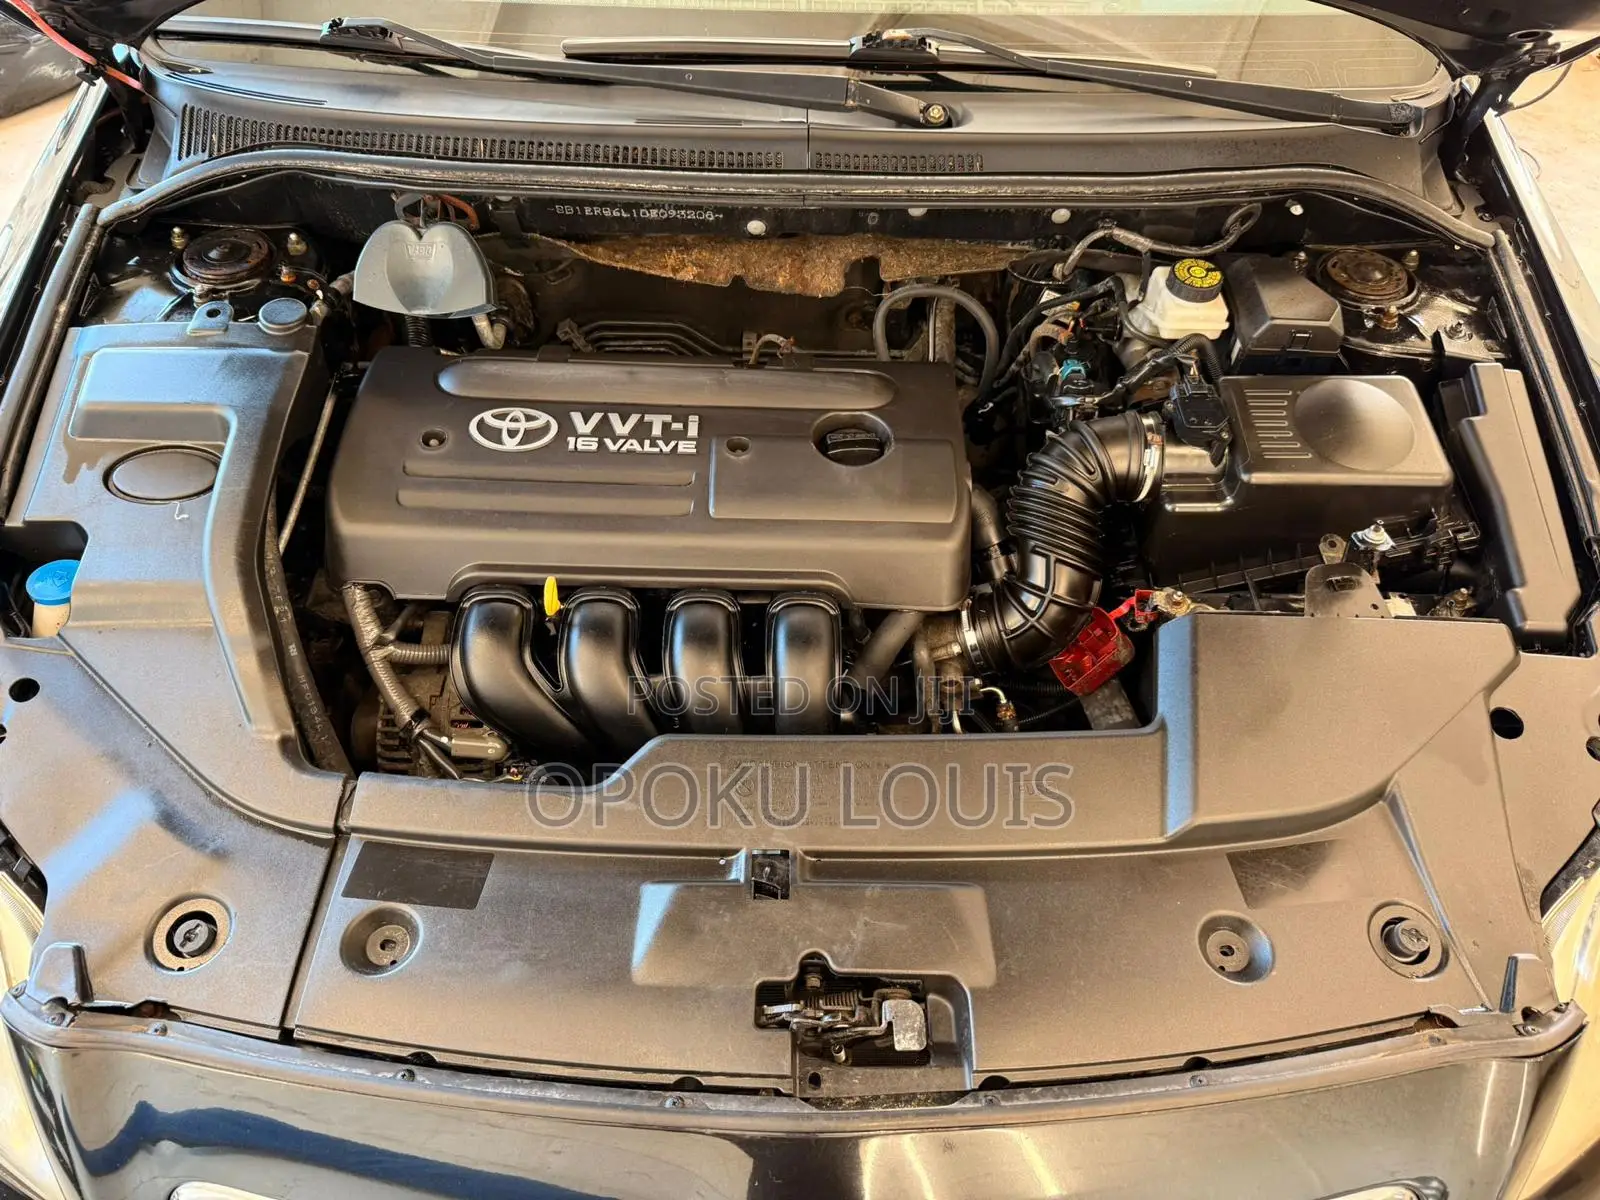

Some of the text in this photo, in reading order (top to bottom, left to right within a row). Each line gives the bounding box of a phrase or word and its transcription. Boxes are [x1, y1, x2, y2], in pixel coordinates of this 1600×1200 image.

[569, 411, 699, 438] VVT-i
[567, 436, 697, 454] 16 VALVE
